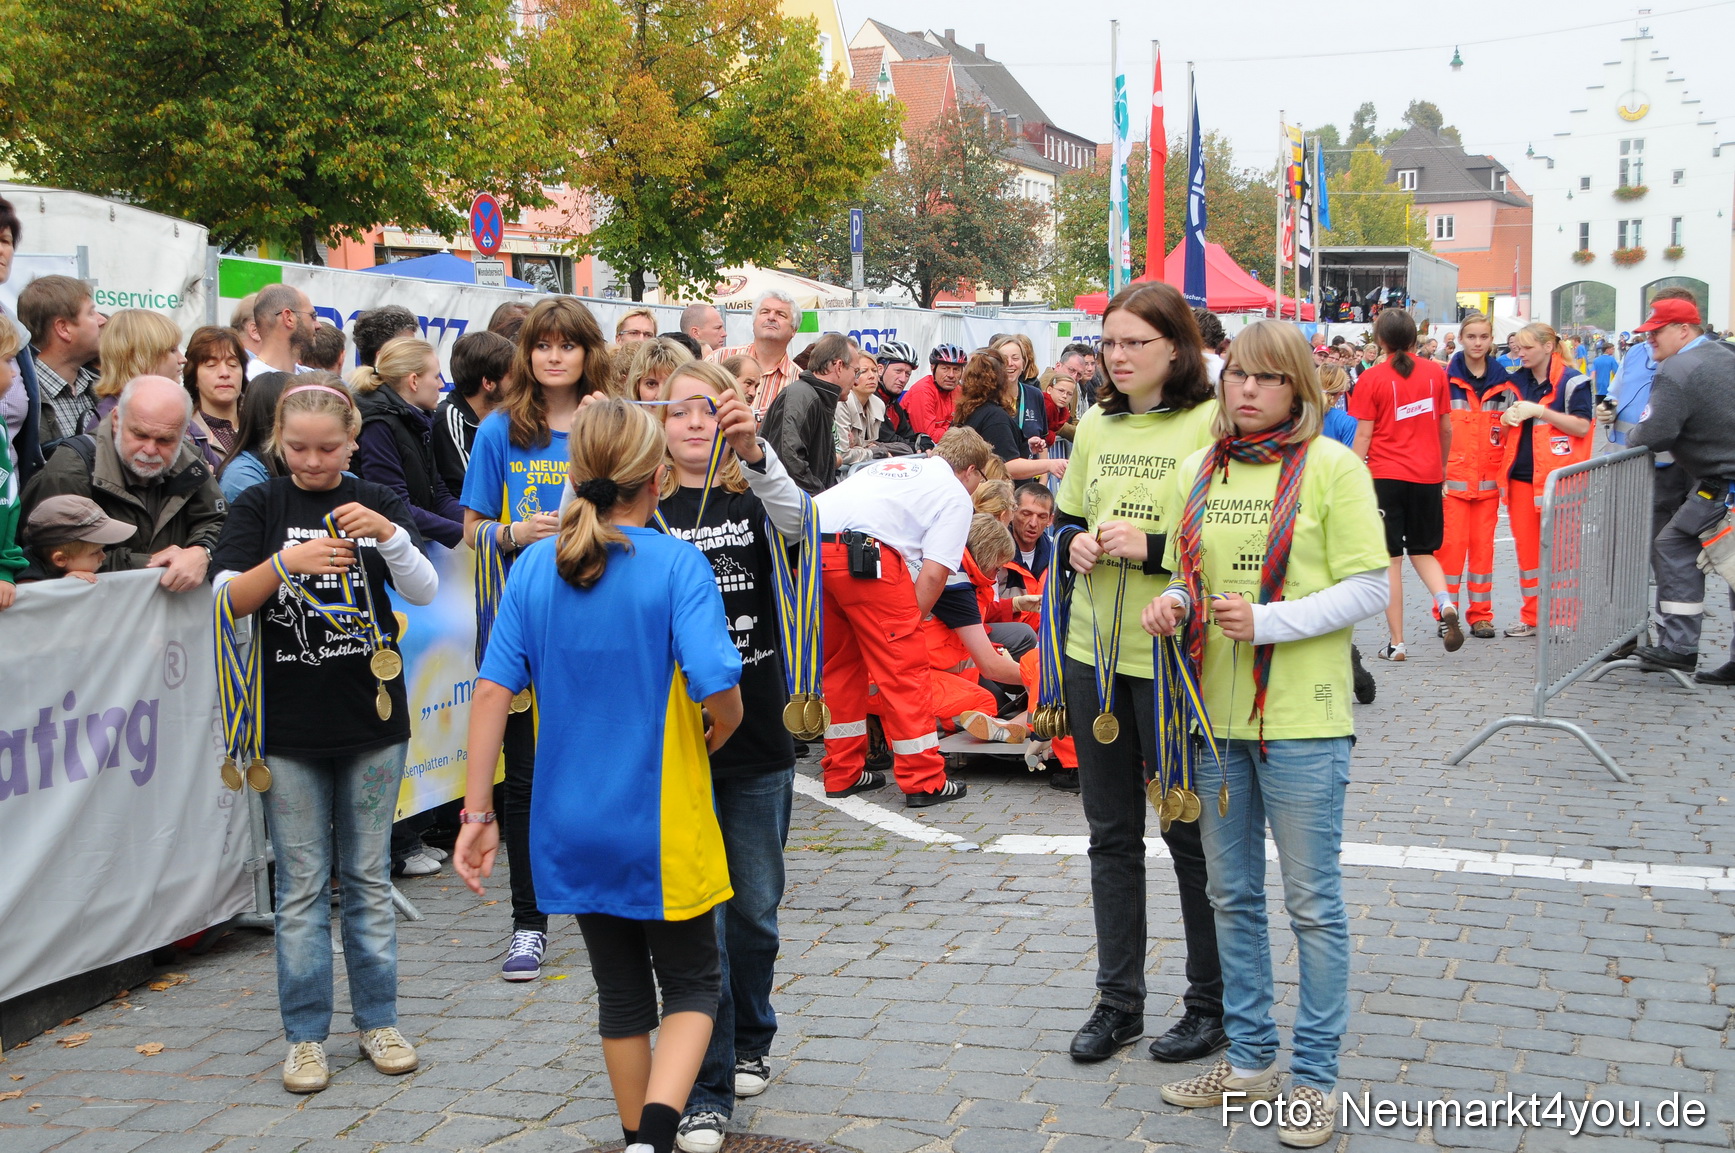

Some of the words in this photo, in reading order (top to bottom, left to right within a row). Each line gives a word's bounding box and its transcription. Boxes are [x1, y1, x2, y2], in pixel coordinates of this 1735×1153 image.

[852, 214, 861, 248] P
[509, 460, 527, 473] 10.
[1097, 453, 1177, 470] NEUMARKTER
[1100, 465, 1167, 481] STADTLAUF
[1204, 499, 1303, 514] NEUMARKR
[694, 531, 755, 551] STADTLAUF
[276, 649, 298, 662] Euer
